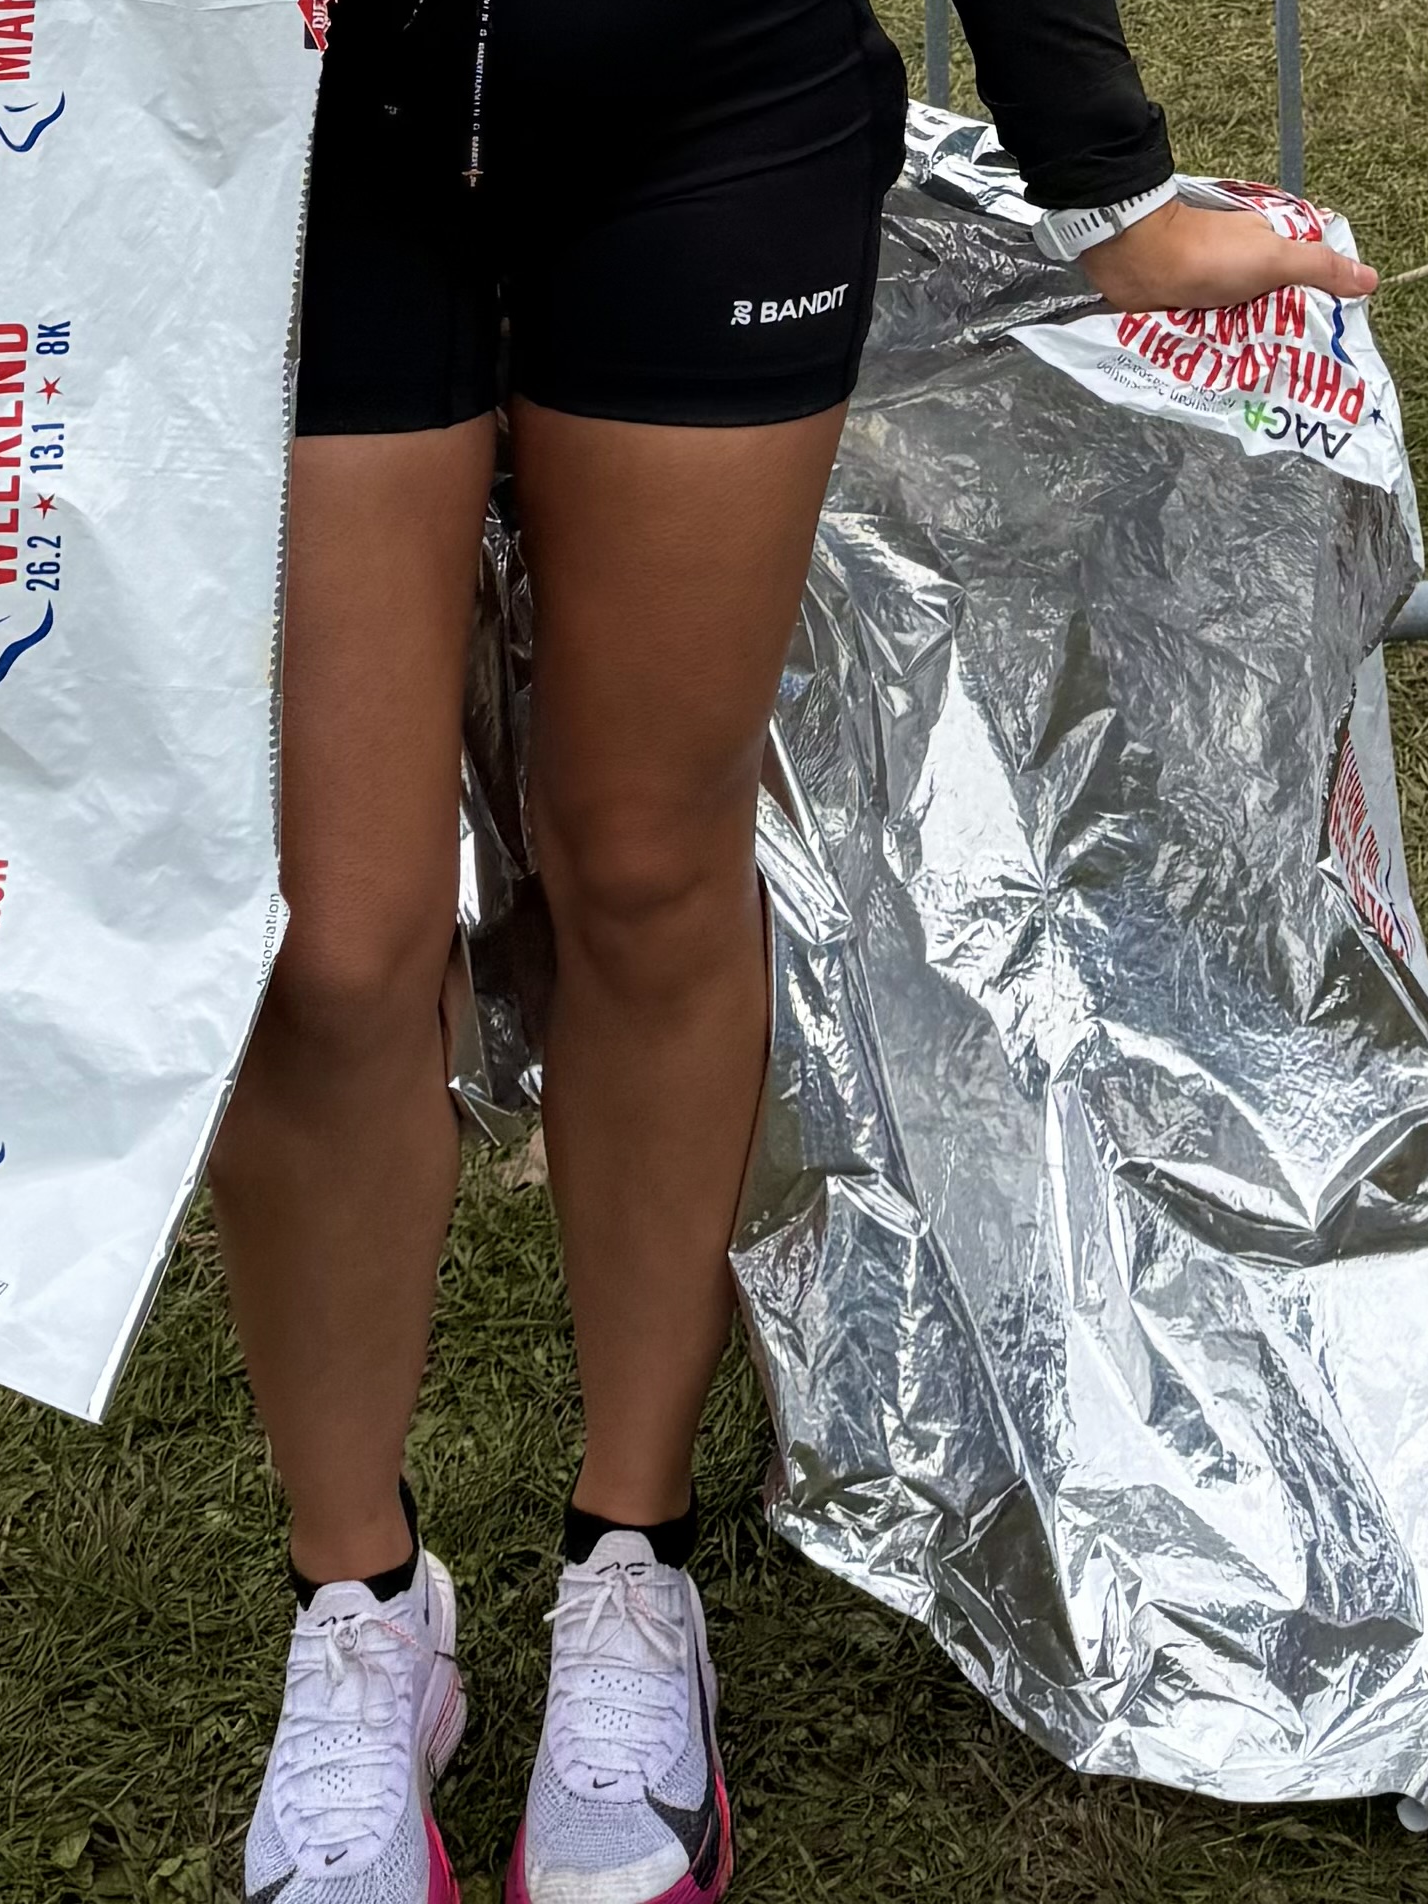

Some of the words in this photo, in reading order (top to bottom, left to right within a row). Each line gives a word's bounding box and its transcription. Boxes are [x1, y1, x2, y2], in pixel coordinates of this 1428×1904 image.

[759, 283, 850, 324] BANDIT
[36, 320, 71, 356] 8K
[30, 422, 65, 474] 13.1
[26, 535, 62, 592] 26.2
